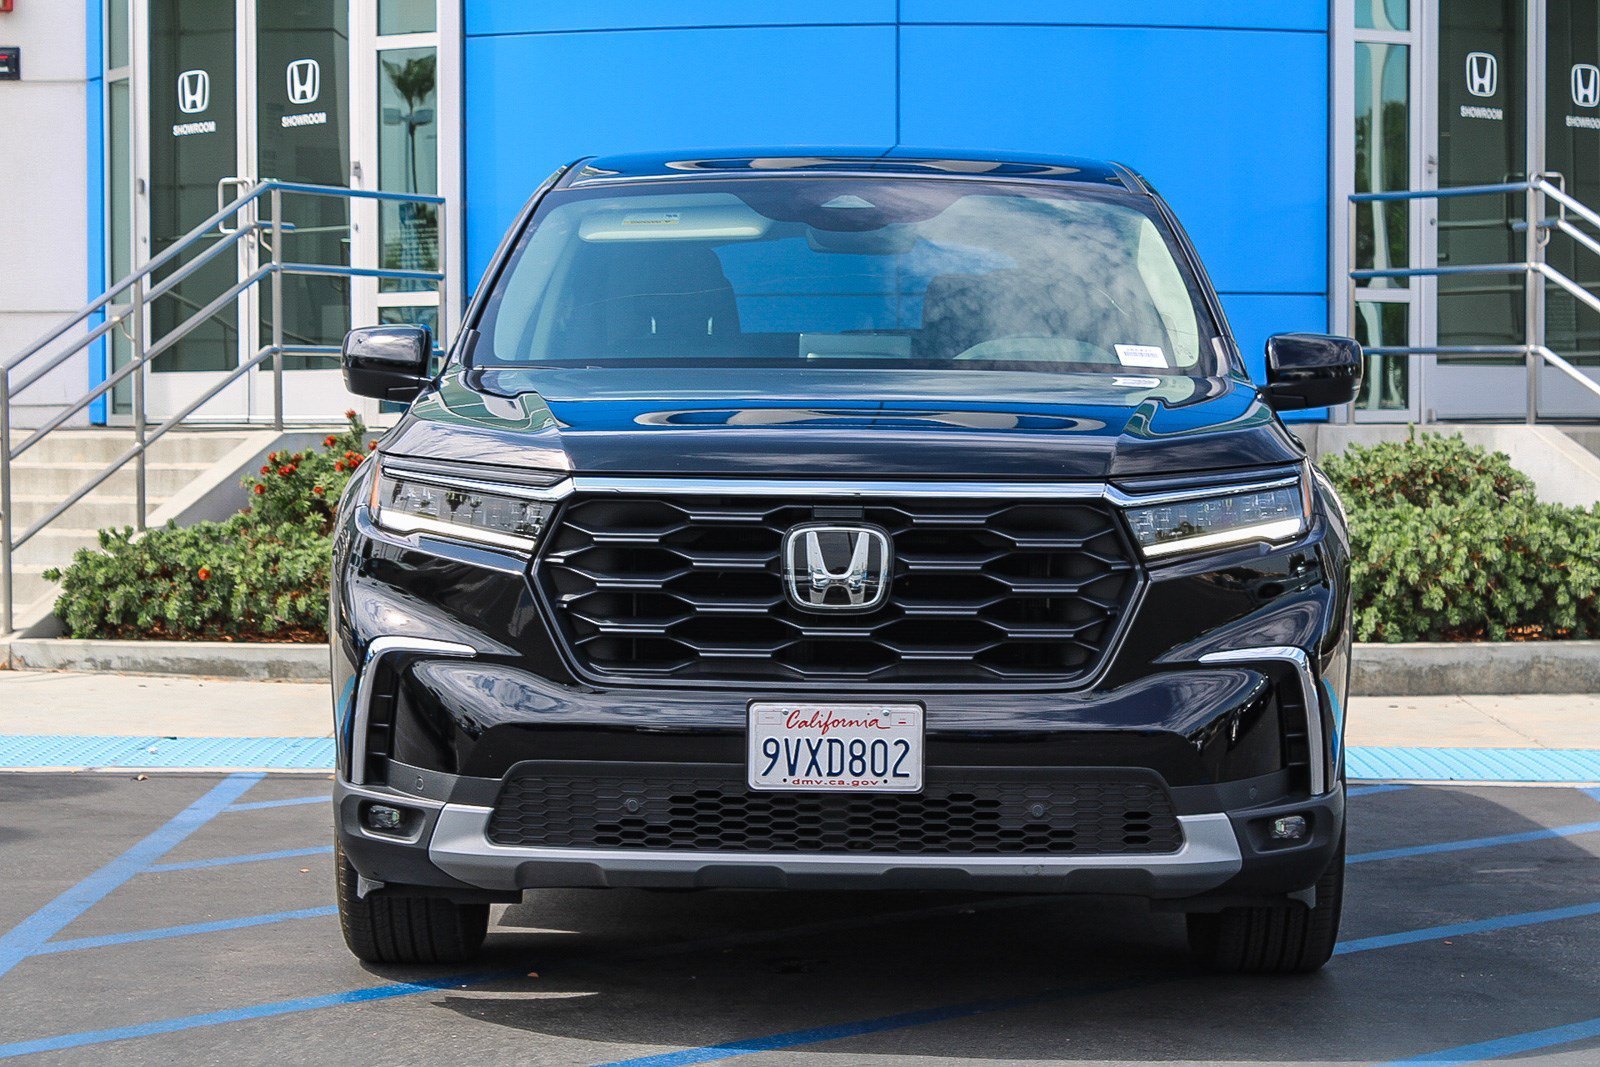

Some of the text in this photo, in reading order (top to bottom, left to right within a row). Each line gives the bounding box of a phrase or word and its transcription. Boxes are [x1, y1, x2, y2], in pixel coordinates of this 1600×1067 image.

[281, 112, 327, 128] SHOWROOM
[1460, 105, 1503, 120] SHOWROOM
[173, 121, 216, 136] SHOWROOM
[1565, 115, 1600, 129] SHOWROO
[786, 710, 890, 735] California
[761, 737, 910, 778] 9VXD802
[792, 778, 879, 787] dmv.ca.gov
